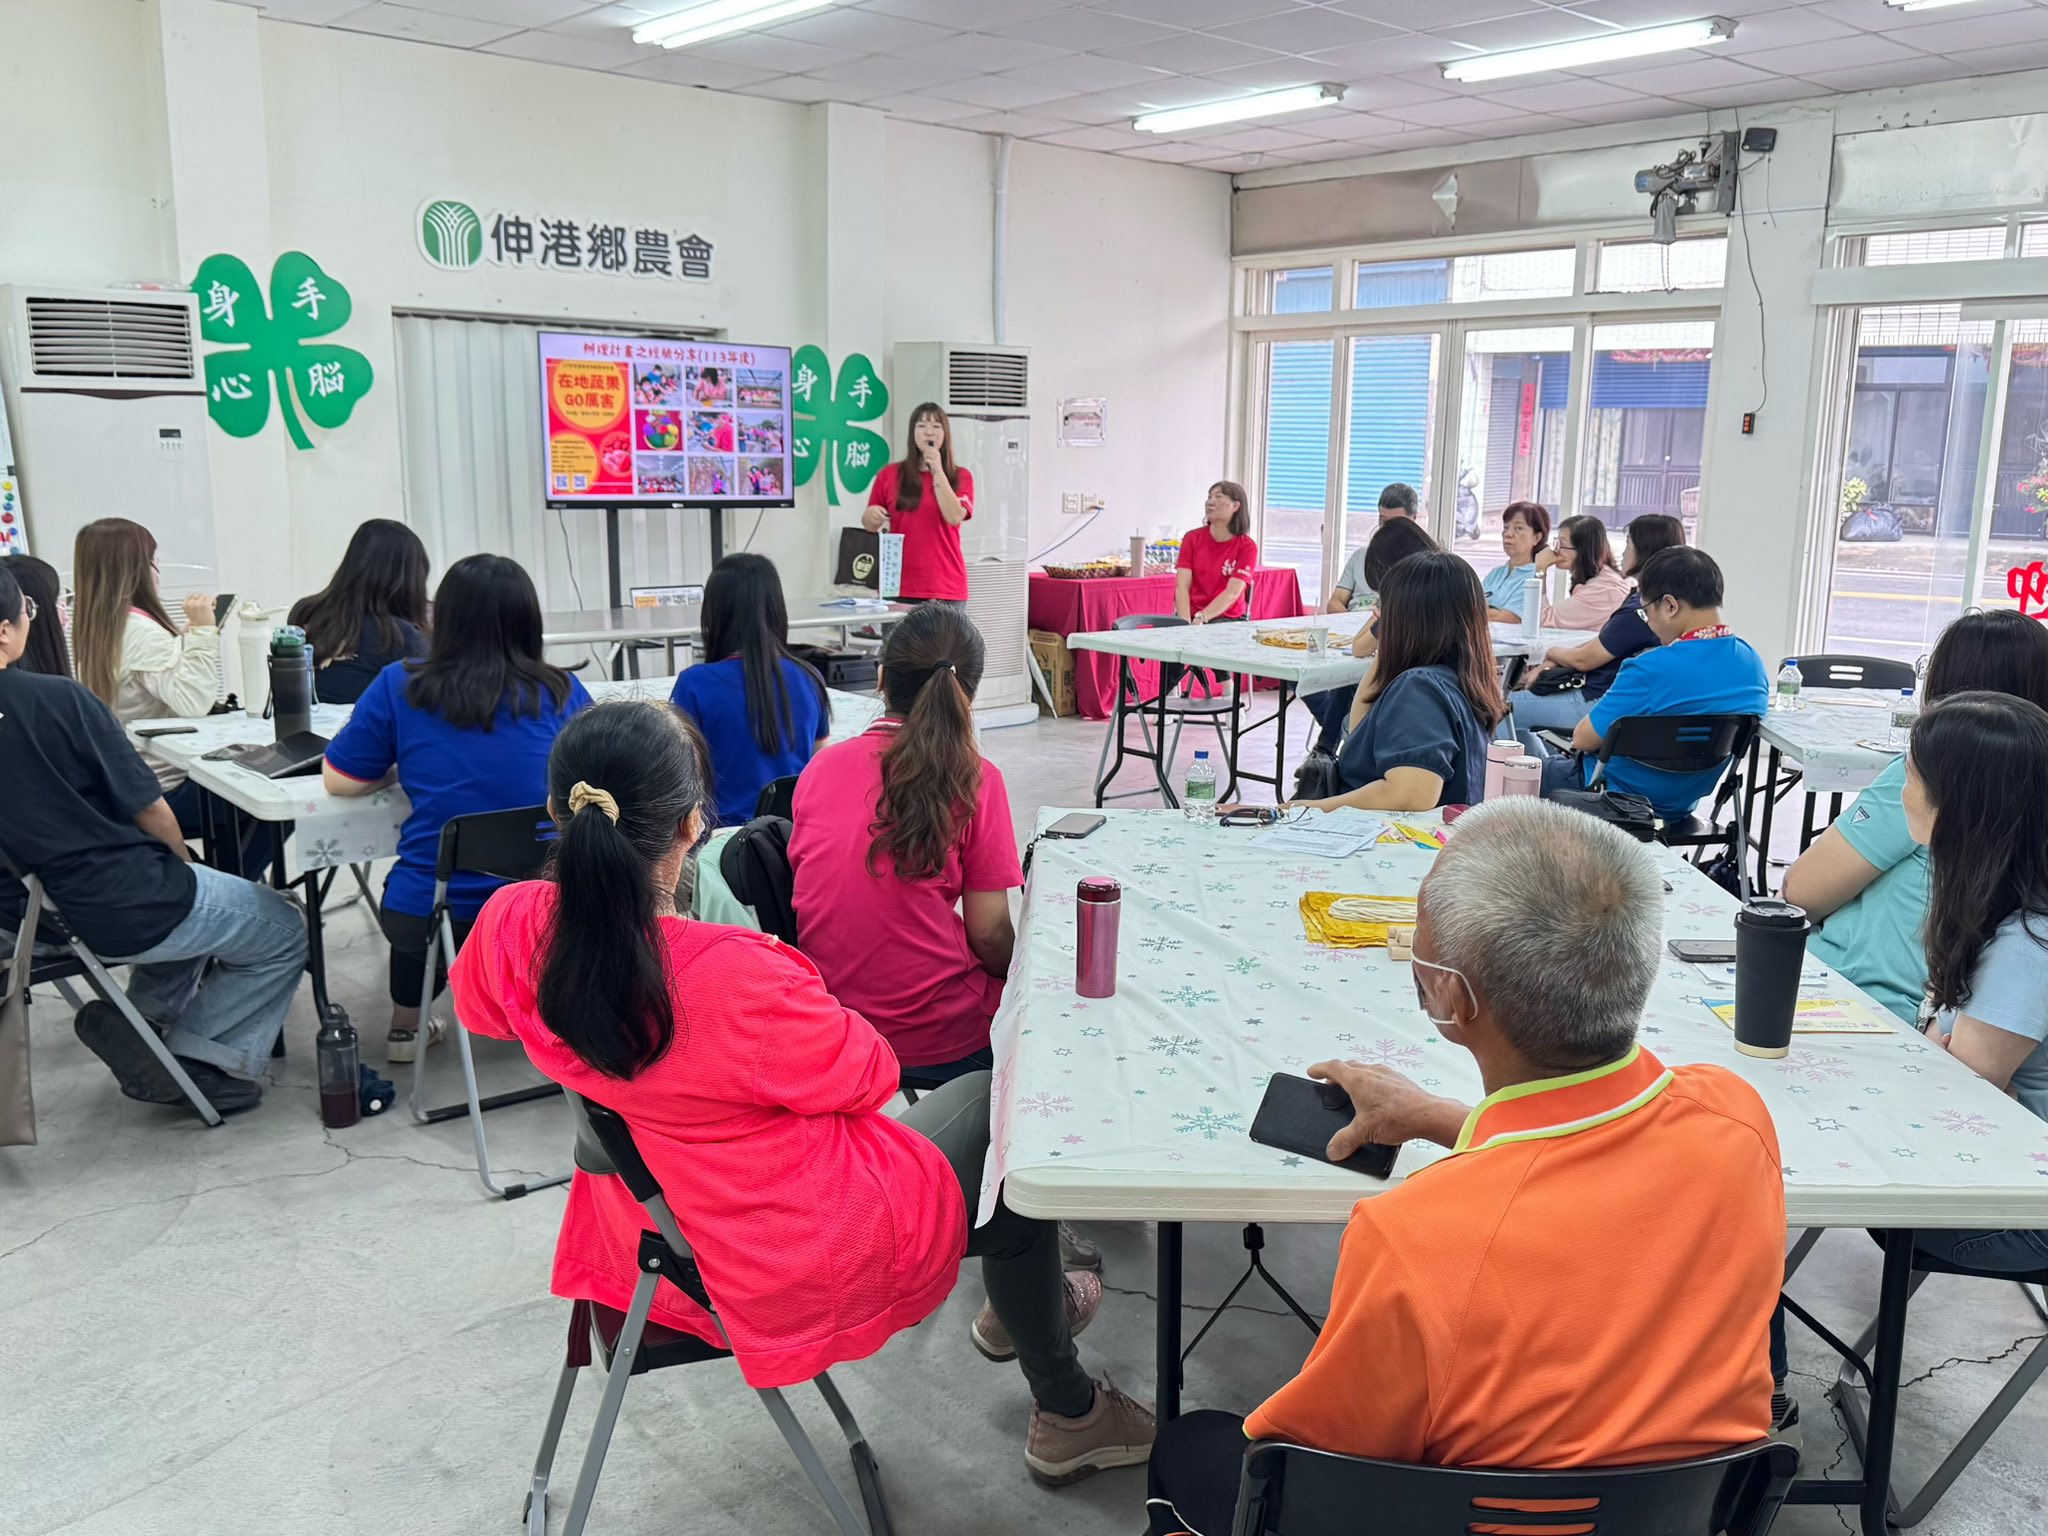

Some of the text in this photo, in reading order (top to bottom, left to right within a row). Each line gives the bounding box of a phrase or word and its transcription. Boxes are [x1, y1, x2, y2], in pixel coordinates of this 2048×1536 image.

[490, 213, 714, 279] 伸港鄉農會
[202, 279, 240, 328] 身
[291, 276, 327, 321] 手
[211, 372, 253, 402] 心
[792, 363, 818, 402] 身
[847, 374, 873, 409] 手
